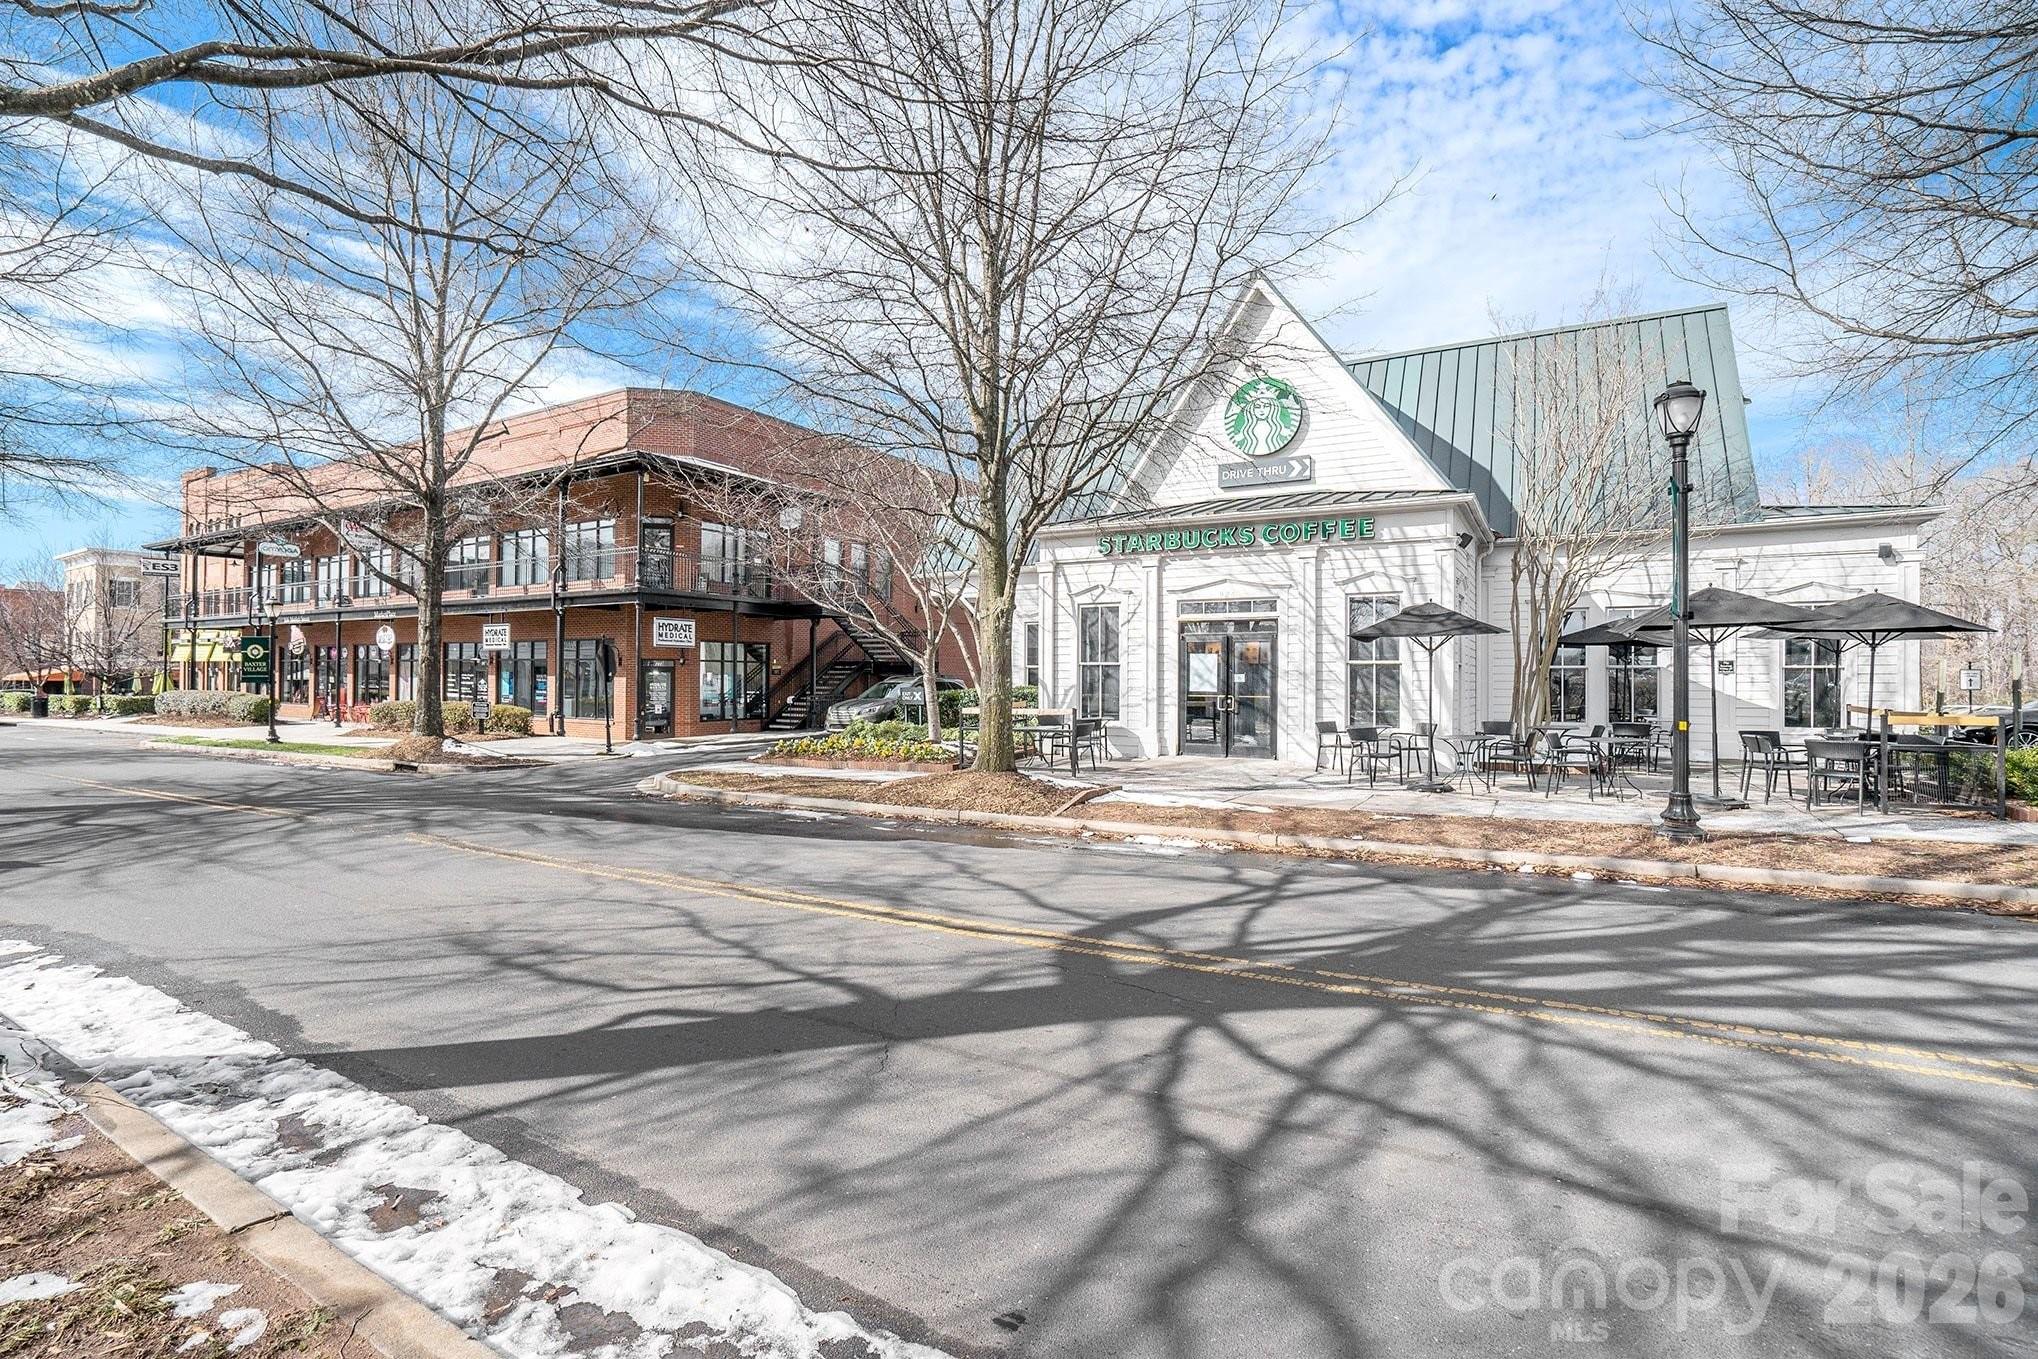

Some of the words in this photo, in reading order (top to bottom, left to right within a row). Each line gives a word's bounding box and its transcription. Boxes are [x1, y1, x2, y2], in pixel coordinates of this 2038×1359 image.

[1222, 468, 1254, 480] DRIVE
[1257, 464, 1287, 477] THRU
[1098, 525, 1255, 555] STARBUCKS
[1260, 516, 1376, 545] COFFEE
[152, 563, 178, 572] ES3
[485, 628, 507, 637] HYDRATE
[658, 622, 693, 633] HYDRATE
